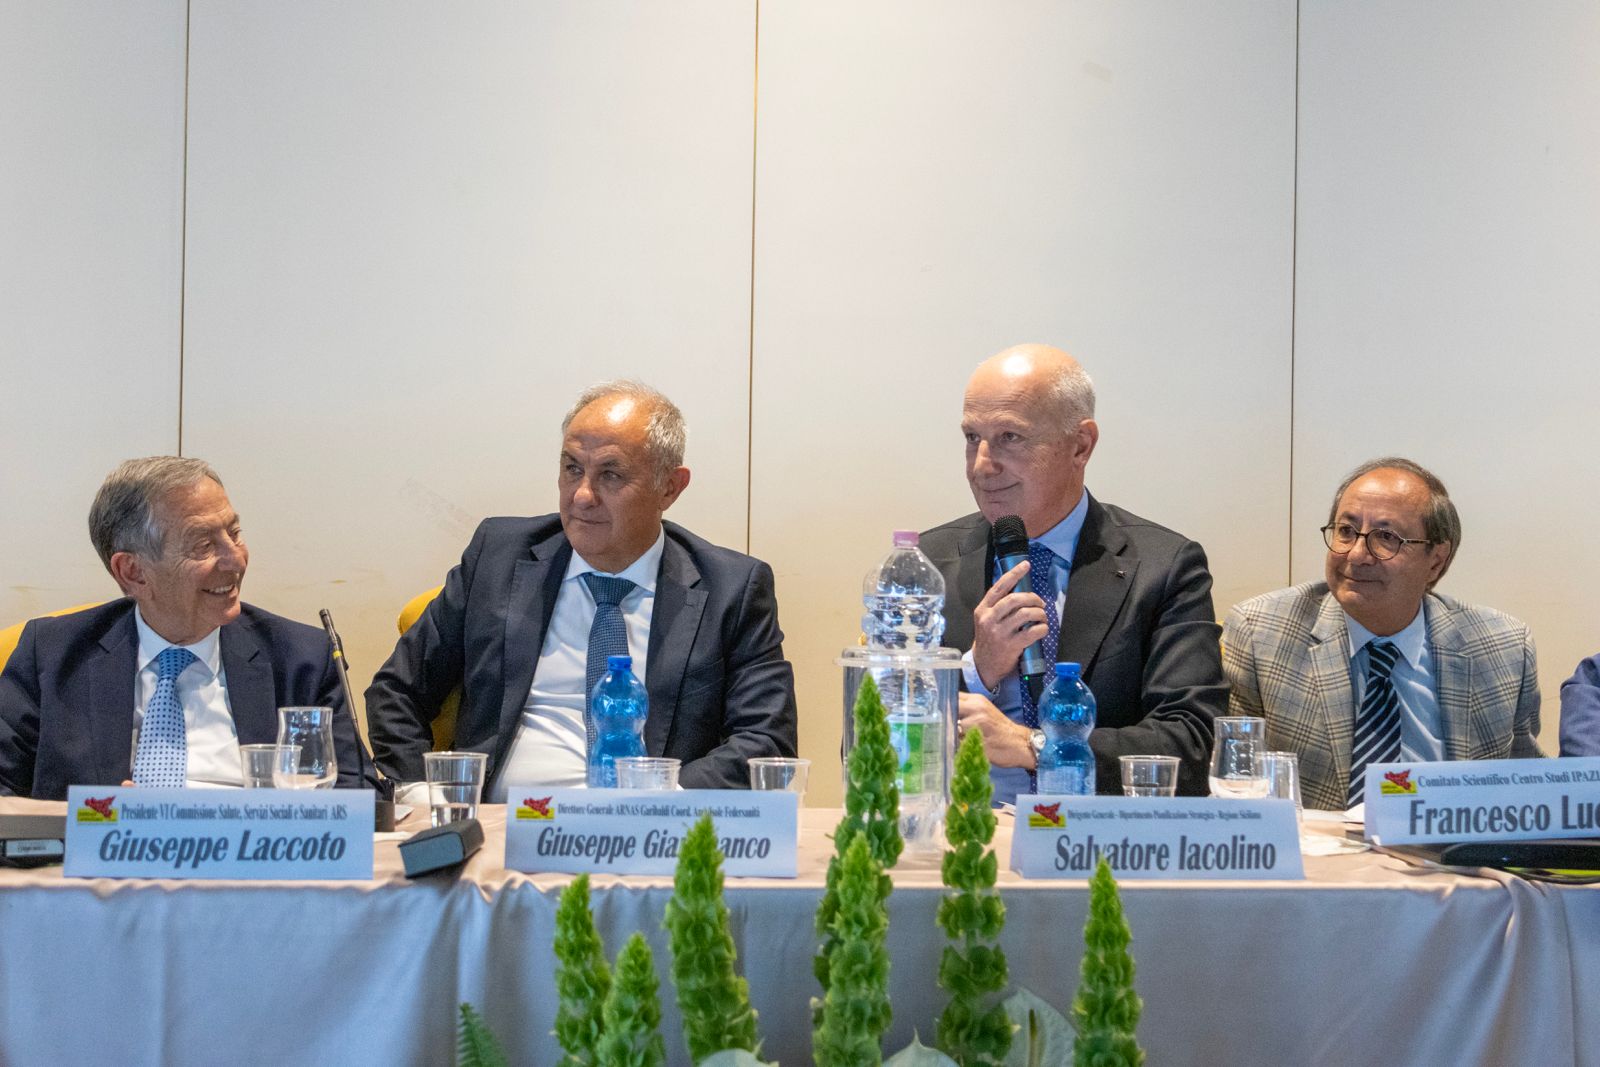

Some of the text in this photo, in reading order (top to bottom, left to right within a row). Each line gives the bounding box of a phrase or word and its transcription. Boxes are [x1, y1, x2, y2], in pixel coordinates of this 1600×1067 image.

[1418, 775, 1460, 787] Comitato
[1462, 773, 1510, 786] Scientifico
[1511, 772, 1544, 785] Centro
[1545, 771, 1570, 783] Studi
[121, 803, 158, 820] Presidente
[170, 803, 217, 820] Commissione
[244, 804, 268, 820] Servizi
[269, 804, 293, 820] Sociali
[300, 804, 328, 820] Sanitari
[331, 804, 348, 820] ARS
[615, 804, 639, 816] ARNAS
[640, 804, 670, 817] Garibaldi
[1409, 799, 1551, 835] Francesco
[99, 829, 346, 869] Giuseppe Laccoto
[537, 827, 771, 864] Giuseppe Giaanco
[1055, 834, 1276, 871] Salvatore Iacolino
